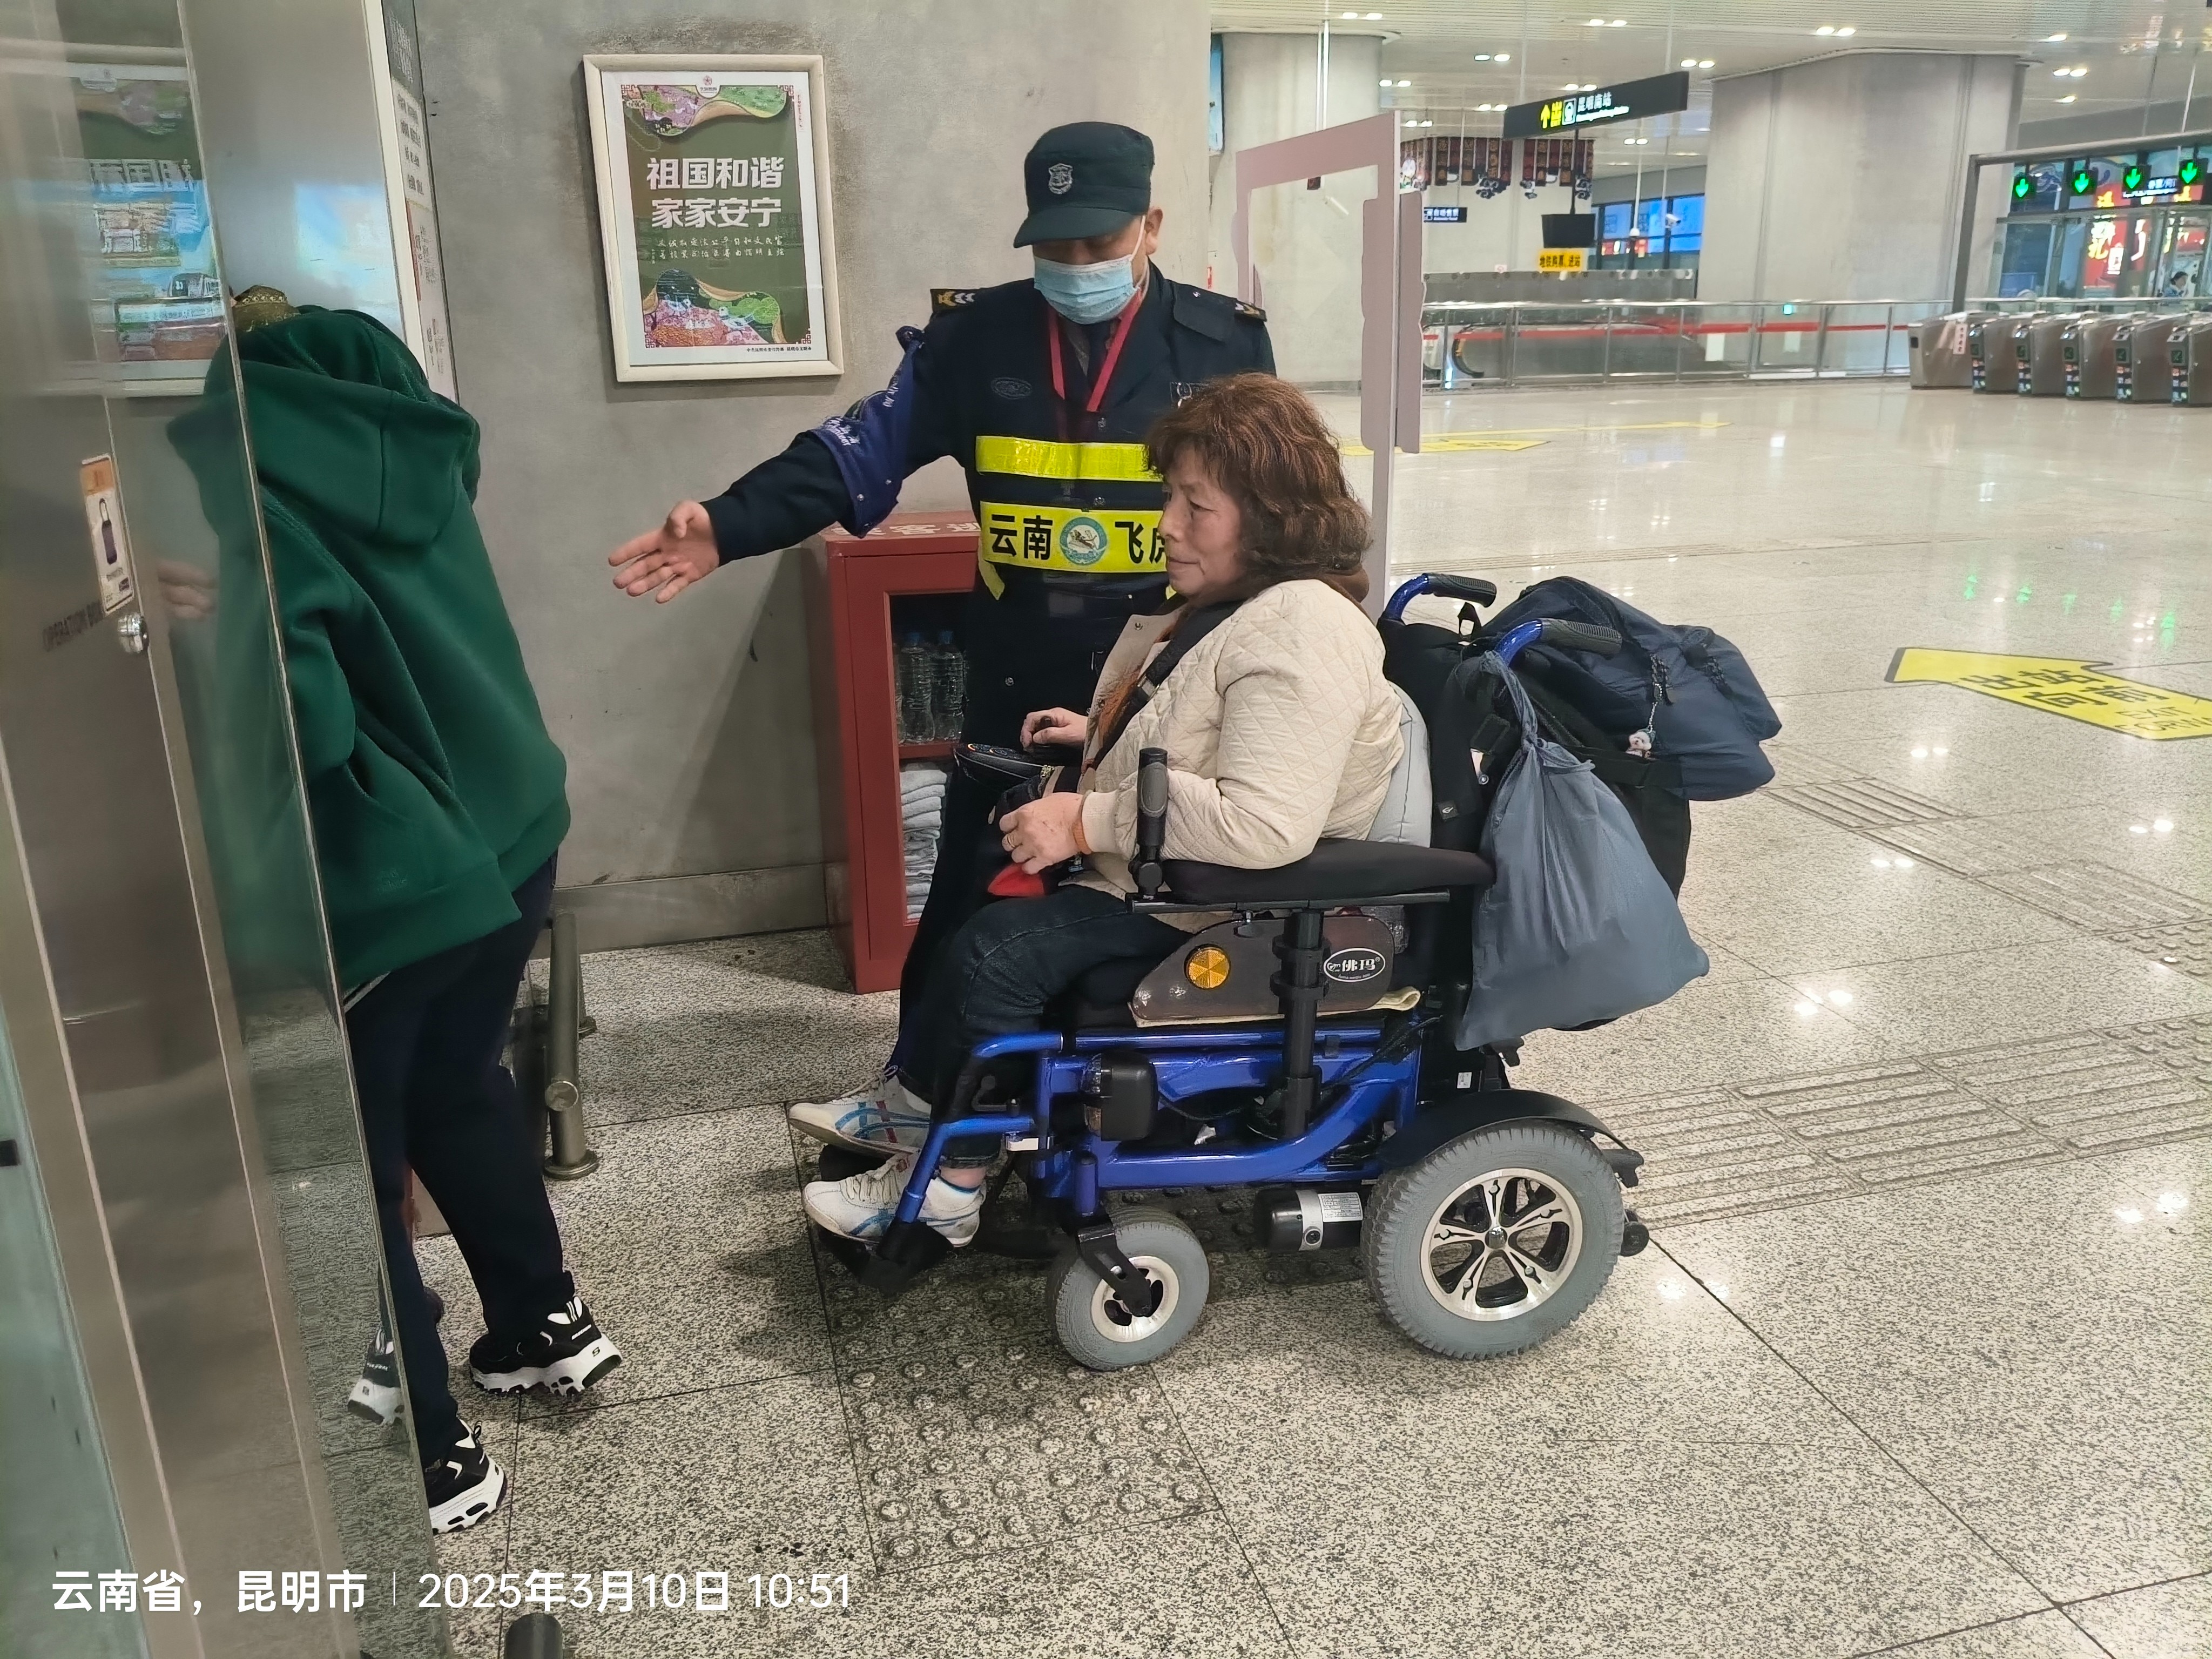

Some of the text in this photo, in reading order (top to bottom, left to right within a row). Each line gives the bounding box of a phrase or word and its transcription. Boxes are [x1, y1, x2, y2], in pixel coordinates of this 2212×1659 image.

[647, 157, 784, 190] 祖国和谐
[652, 198, 782, 228] 家家安宁
[990, 515, 1053, 560] 云南
[1960, 669, 2106, 690] 出站
[2021, 685, 2170, 709] 向前
[2115, 706, 2191, 720] EXIT
